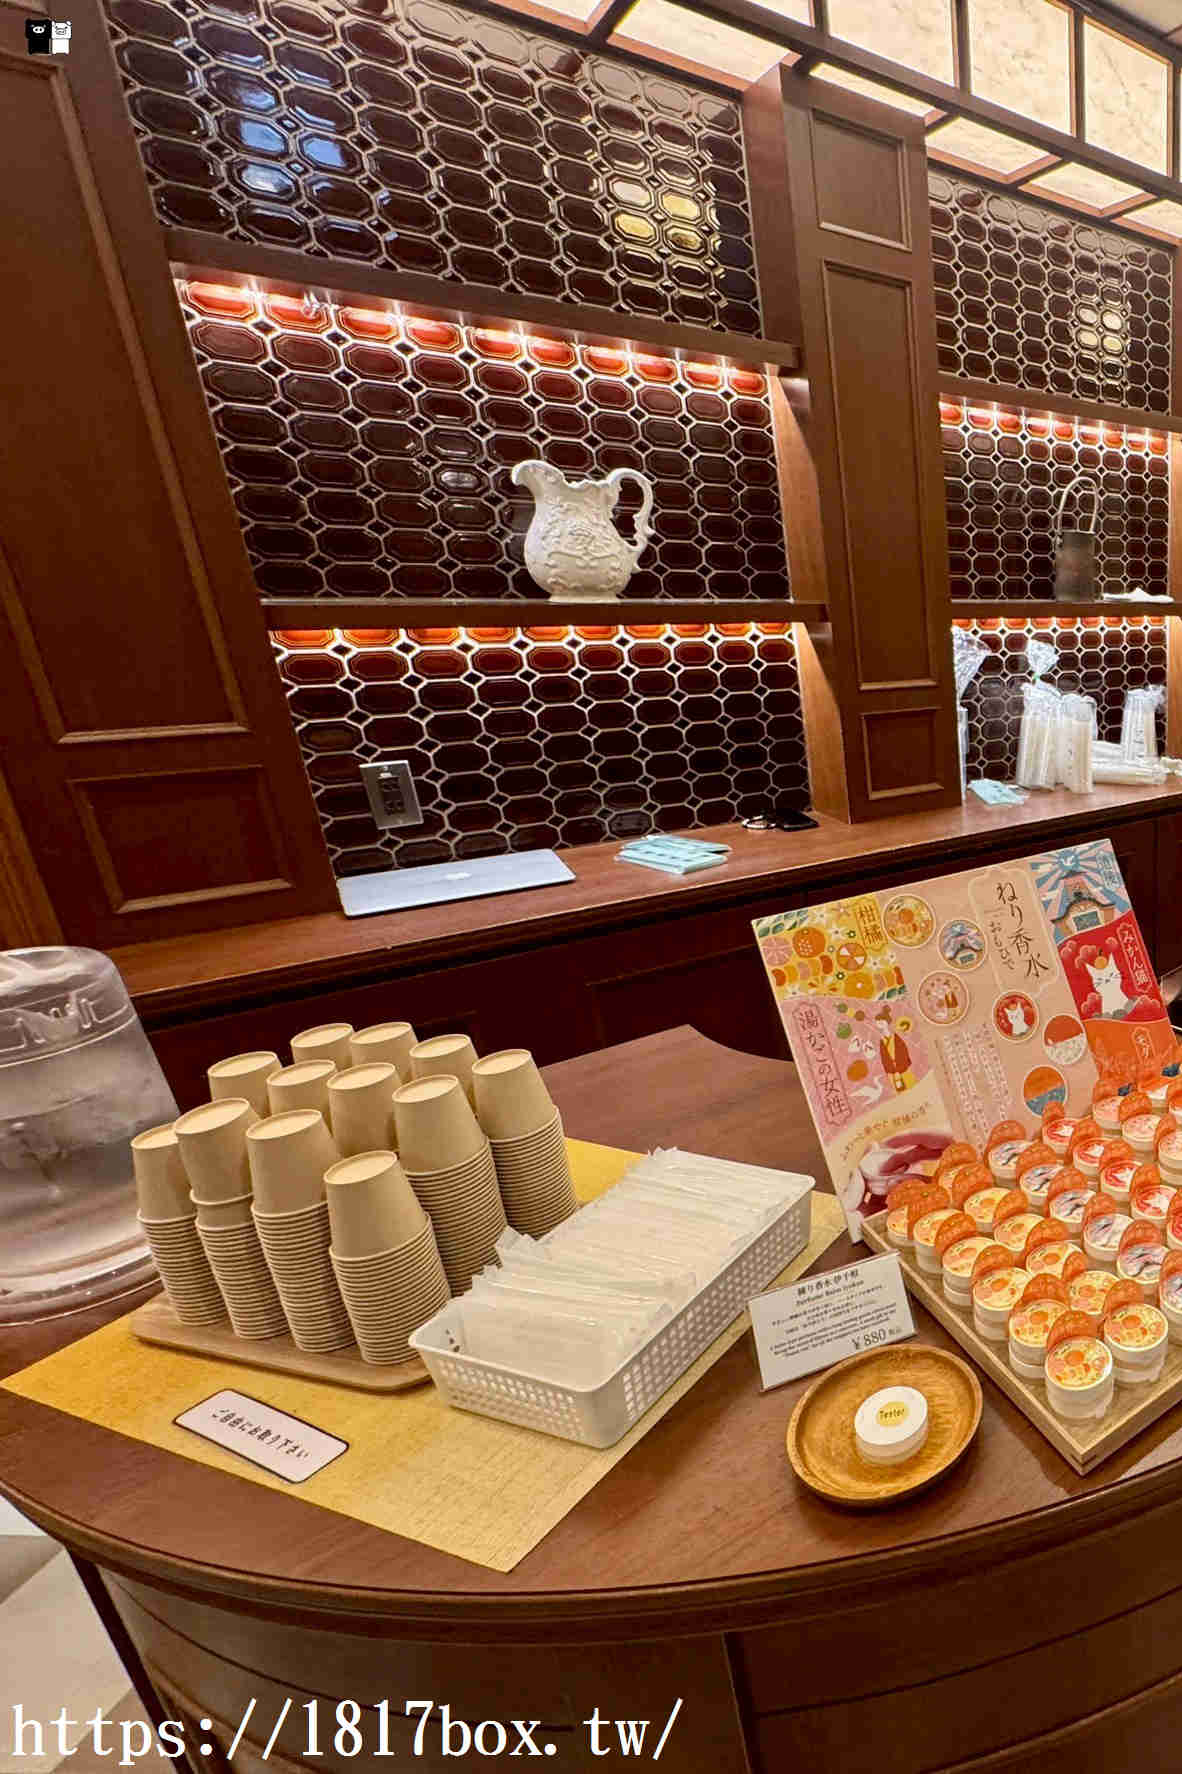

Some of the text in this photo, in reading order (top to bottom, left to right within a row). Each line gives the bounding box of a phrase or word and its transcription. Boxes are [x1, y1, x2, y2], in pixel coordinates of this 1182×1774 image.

[996, 882, 1049, 978] ねり香水
[879, 1407, 905, 1420] Tester
